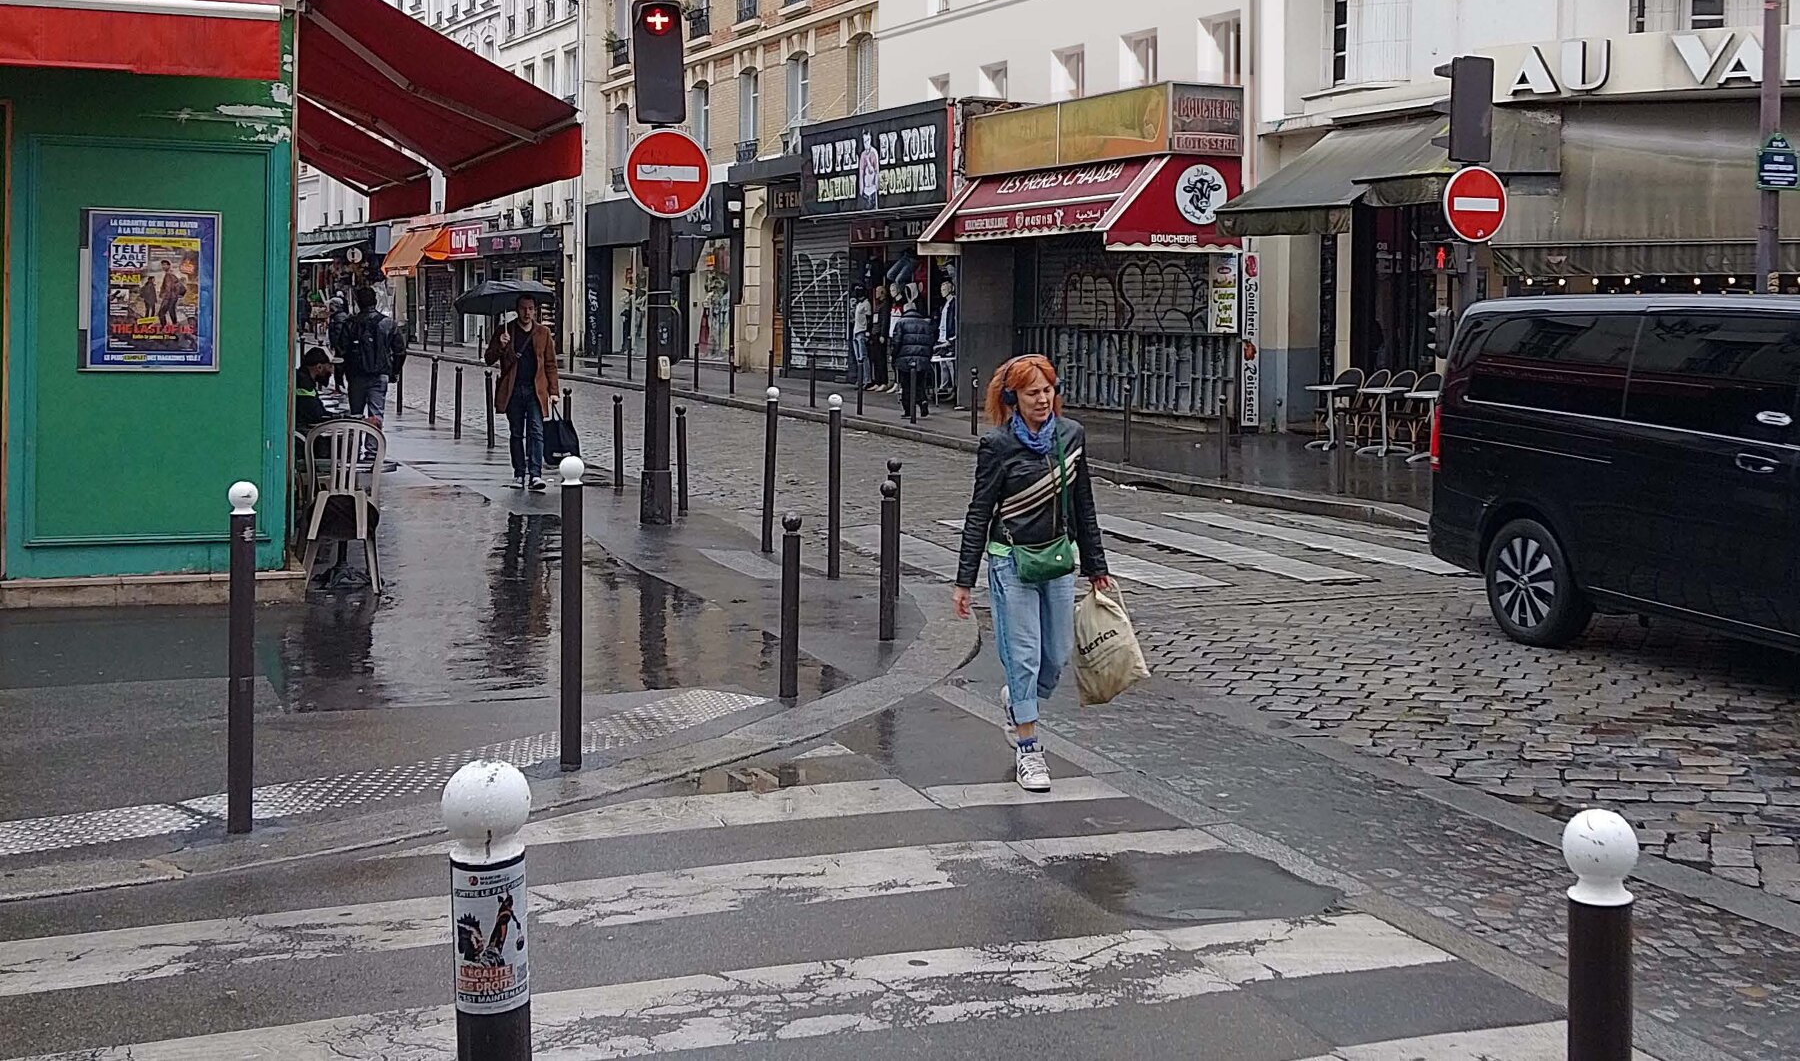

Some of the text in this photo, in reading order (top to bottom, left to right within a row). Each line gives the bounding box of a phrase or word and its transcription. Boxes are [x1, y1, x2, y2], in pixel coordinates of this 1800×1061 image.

[1507, 39, 1610, 96] AU
[1177, 97, 1240, 120] BOUCHERIE
[879, 131, 898, 165] BY
[817, 162, 937, 202] FASHION SPORTSWEAR
[996, 177, 1020, 194] LES
[1062, 162, 1125, 187] CHAABA
[774, 191, 784, 208] LE
[112, 242, 147, 253] TÉLÉ
[452, 230, 467, 252] Only
[1151, 234, 1198, 244] BOUCHERIE
[1245, 280, 1258, 337] Boucherie
[112, 324, 194, 334] THE LAST OF US
[1243, 361, 1257, 423] Rôtisserie
[480, 889, 490, 897] LE
[476, 977, 515, 990] DROITS
